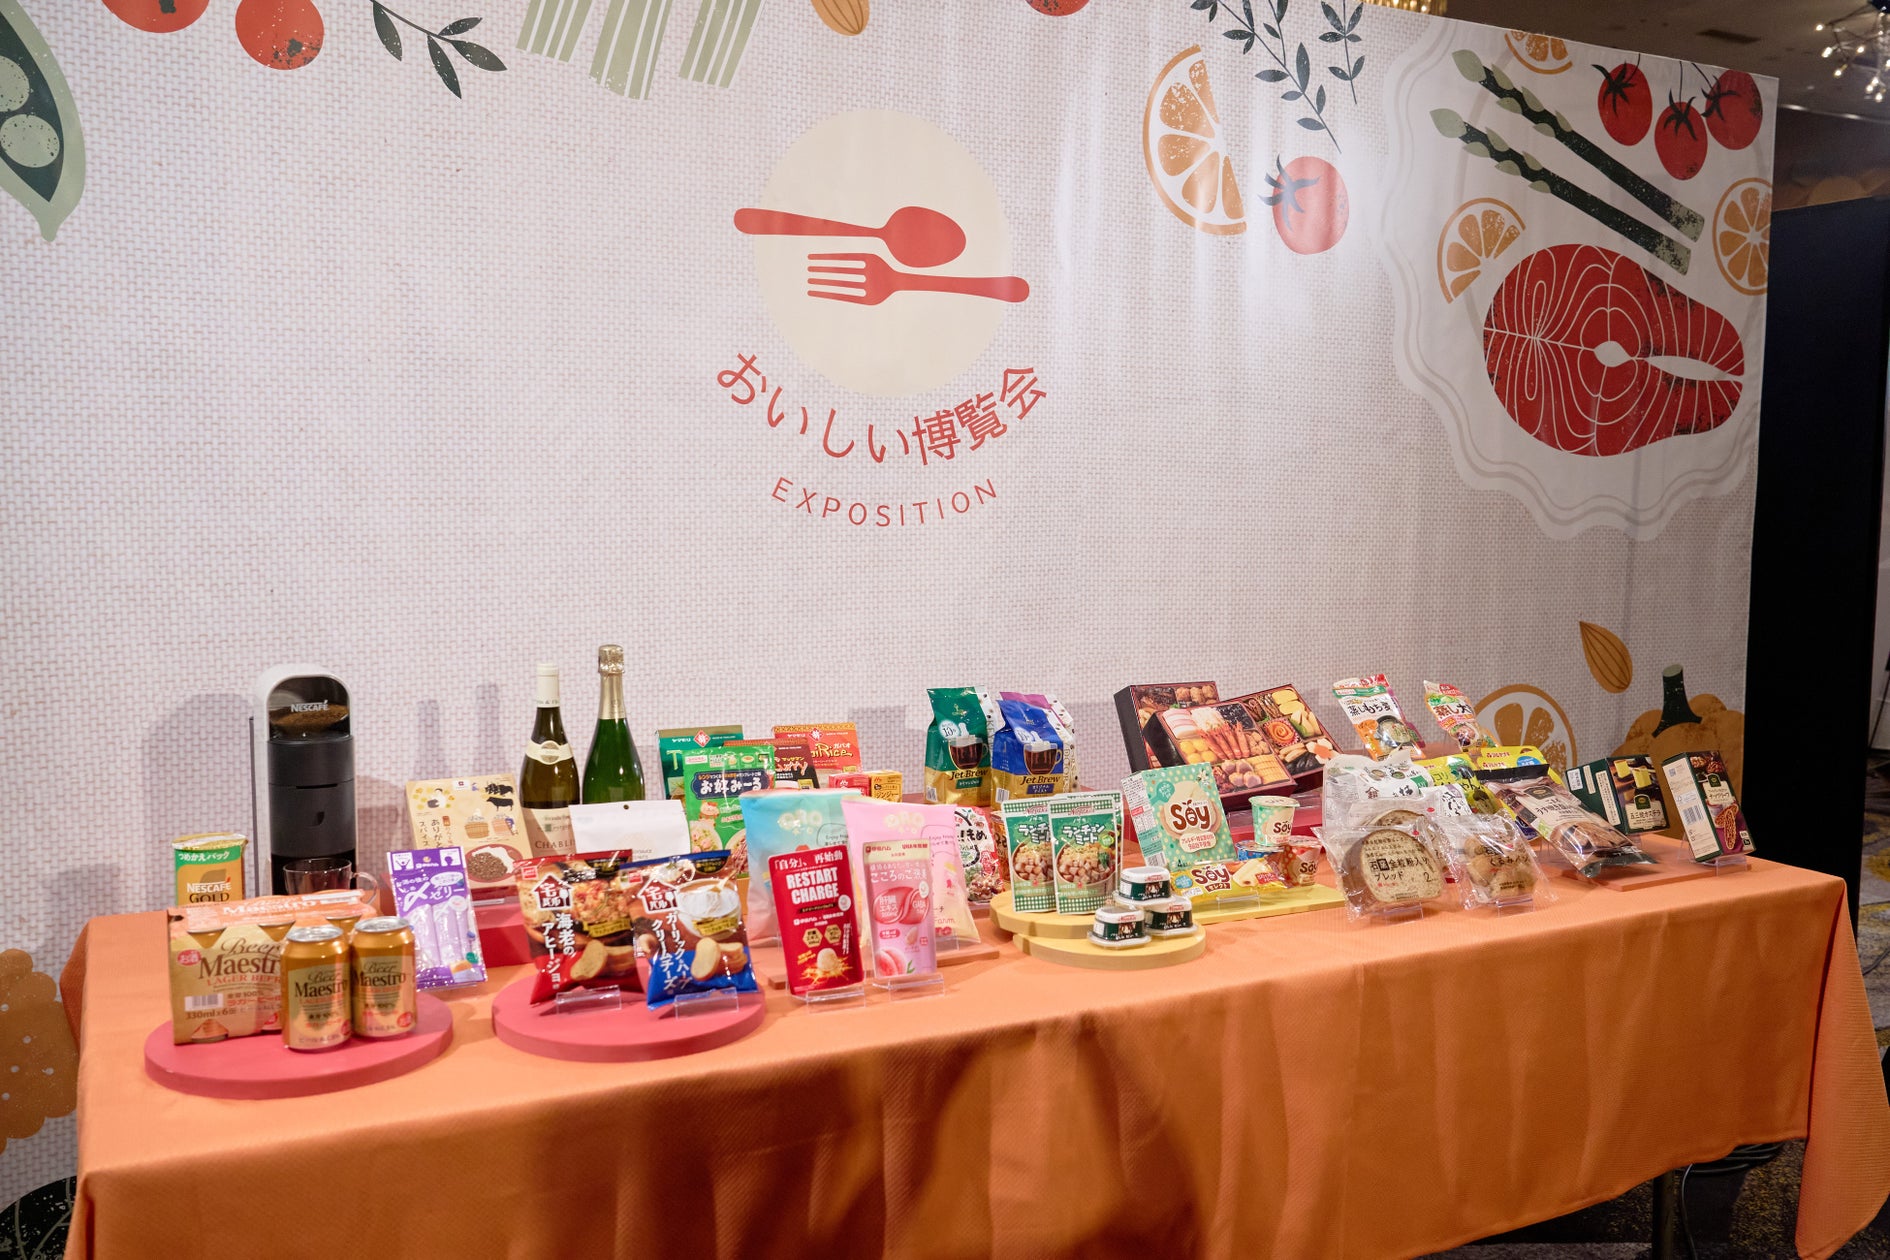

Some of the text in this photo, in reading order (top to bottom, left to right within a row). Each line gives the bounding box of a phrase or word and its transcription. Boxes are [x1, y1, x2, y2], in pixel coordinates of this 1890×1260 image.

[716, 352, 1047, 466] おいしい博覧会
[771, 477, 998, 527] EXPOSITION
[290, 699, 330, 713] NESCAFÉ
[950, 769, 988, 780] Jet Brew
[1020, 776, 1061, 785] Jet Brew
[700, 776, 762, 795] お好みーる
[1170, 803, 1211, 831] Soy
[1062, 823, 1105, 838] ランチョン
[1076, 832, 1098, 845] ミート
[535, 839, 576, 849] CHABLI
[178, 851, 230, 862] つめかえパック
[186, 876, 232, 893] NESCAFÉ
[786, 867, 838, 890] RESTART
[1190, 867, 1231, 885] Soy
[189, 892, 230, 904] GOLD
[790, 883, 840, 905] CHARGE
[555, 912, 577, 958] 海老の
[198, 954, 281, 979] Maestr
